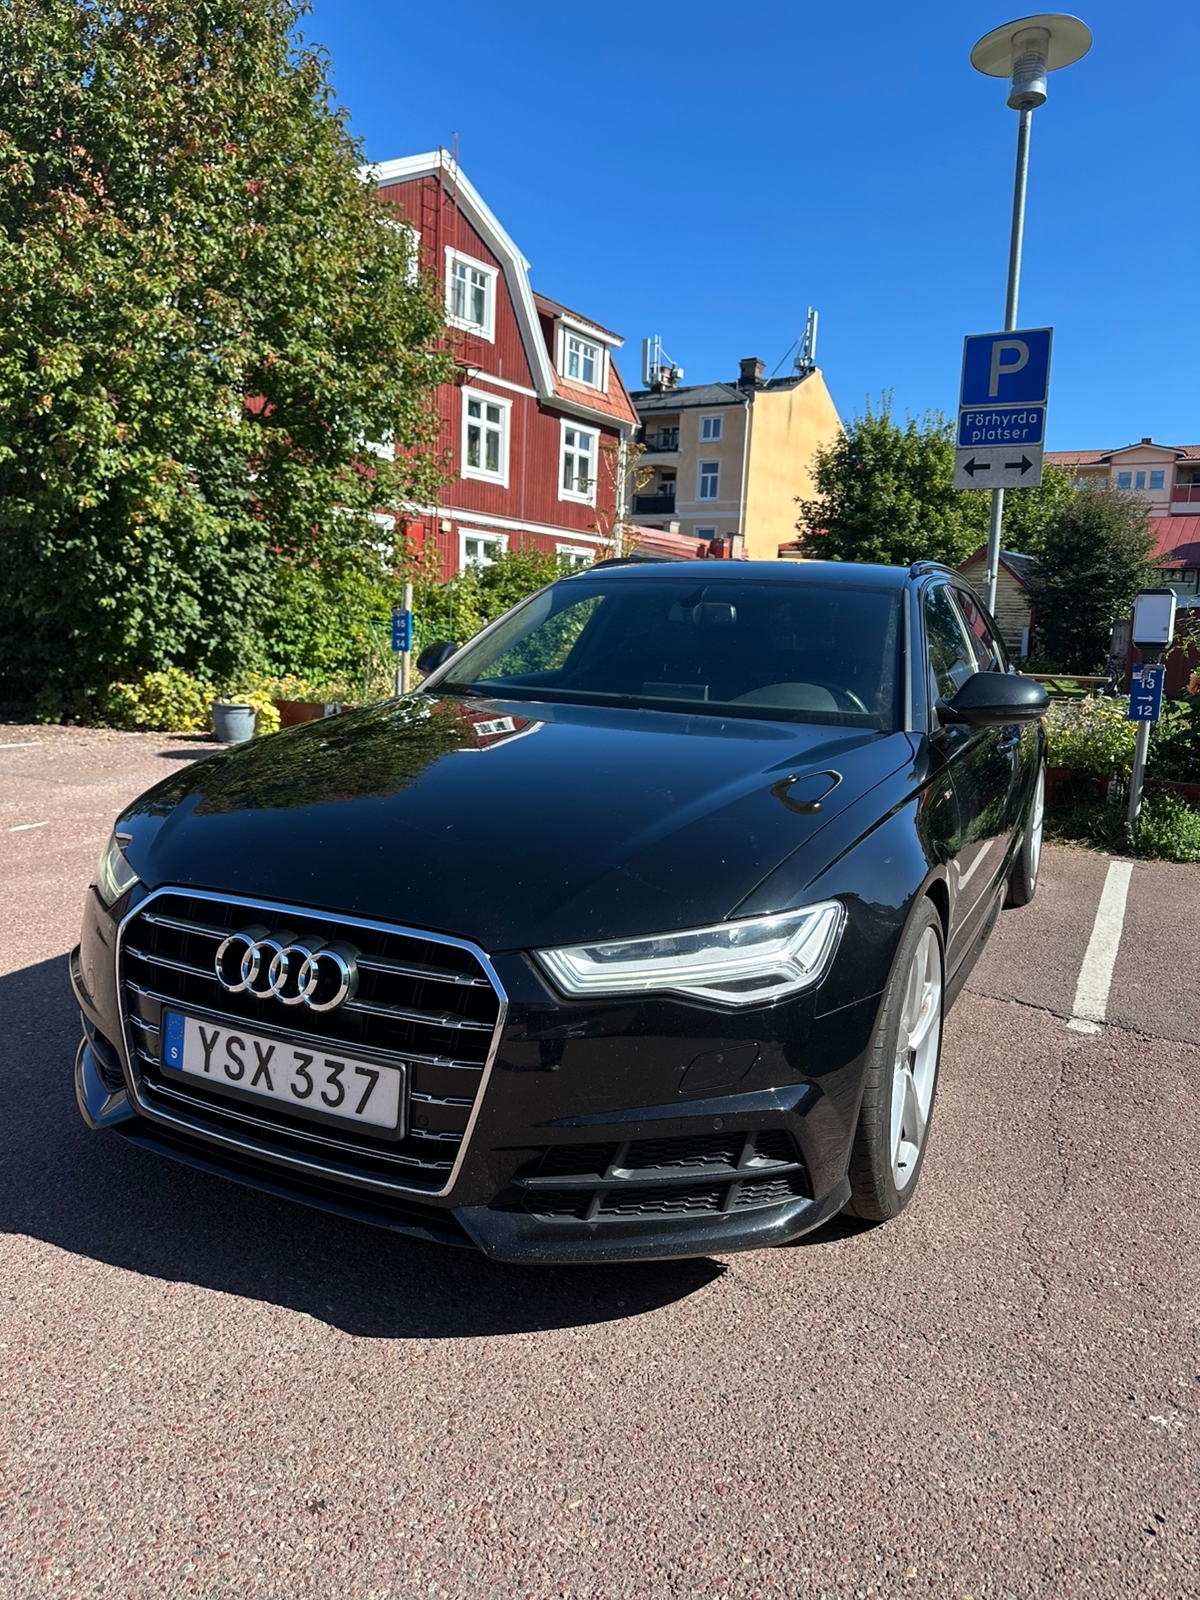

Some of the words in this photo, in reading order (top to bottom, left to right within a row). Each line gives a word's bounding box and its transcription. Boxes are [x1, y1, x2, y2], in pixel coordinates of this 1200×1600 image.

[988, 339, 1030, 397] P
[966, 411, 1038, 428] Förhyrda
[972, 428, 1029, 443] platser
[396, 619, 406, 628] 15
[396, 639, 406, 648] 14
[1140, 678, 1155, 689] 13
[1137, 704, 1153, 716] 12
[170, 1046, 178, 1059] S
[198, 1025, 276, 1091] YSX
[290, 1051, 380, 1115] 337
